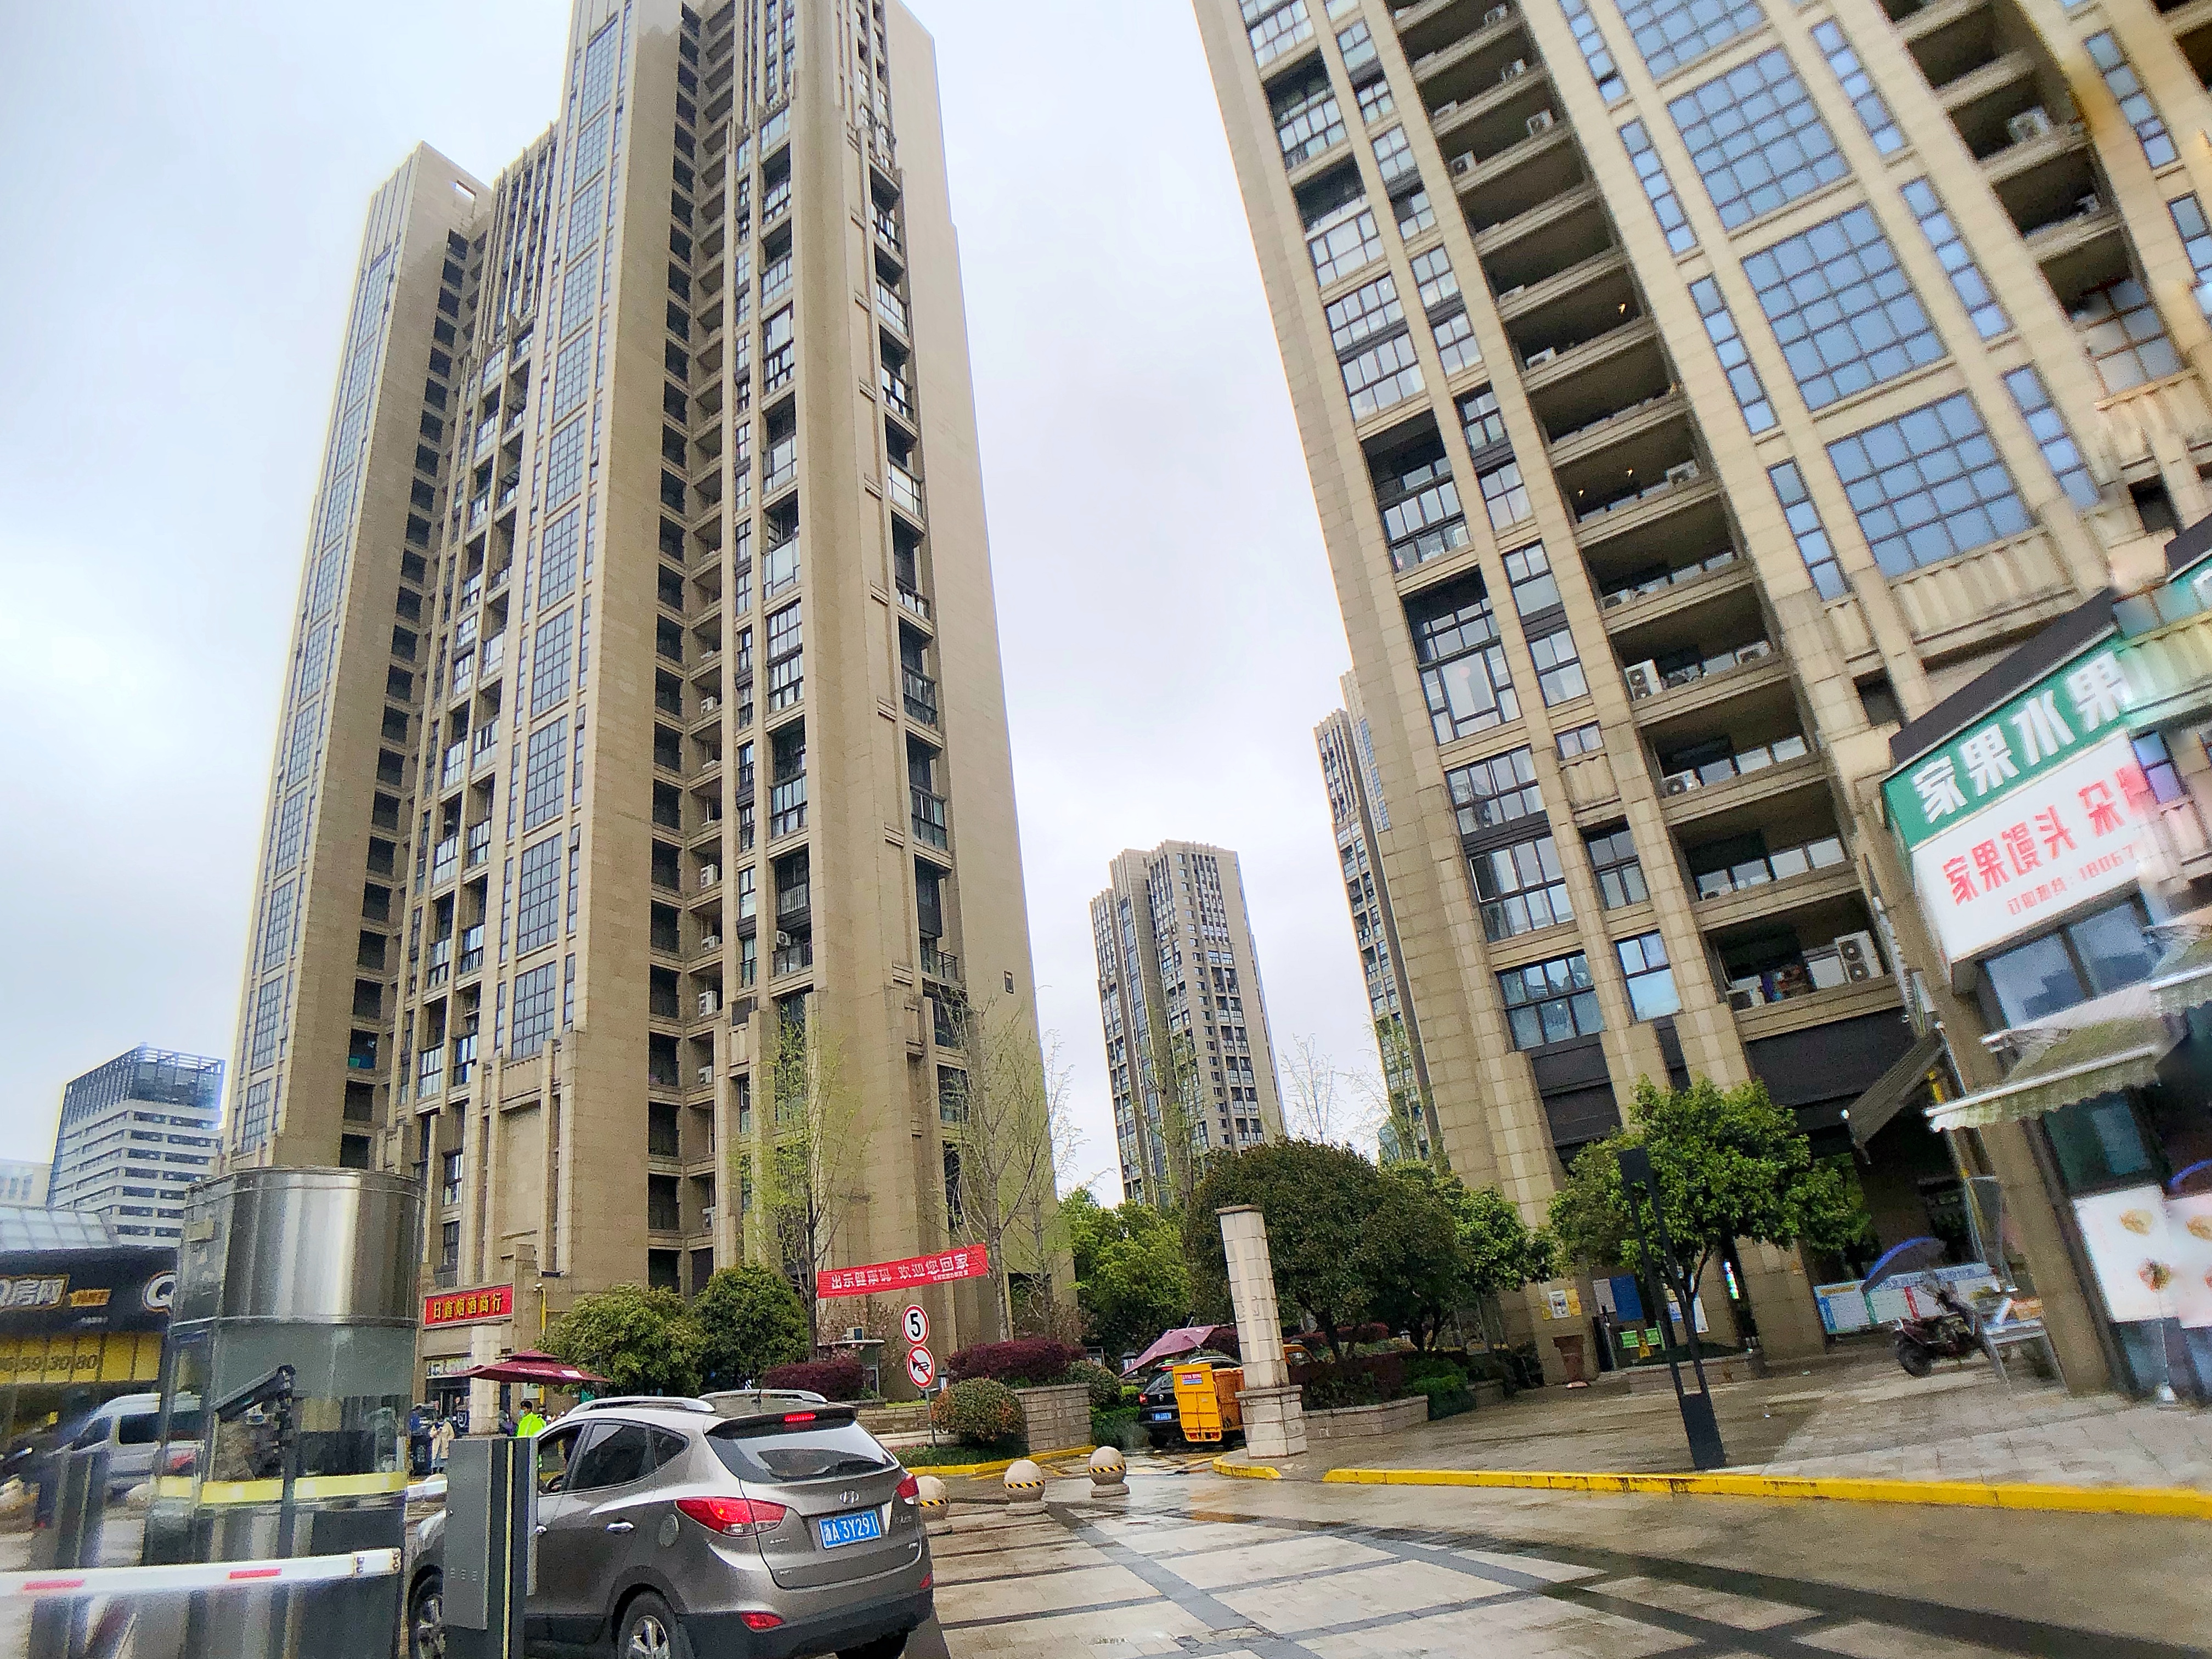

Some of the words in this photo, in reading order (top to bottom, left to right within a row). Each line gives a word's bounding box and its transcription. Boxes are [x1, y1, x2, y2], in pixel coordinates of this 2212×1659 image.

[1912, 651, 2133, 823] 家果水果
[1943, 804, 2078, 906] 家果馒头
[831, 1267, 892, 1289] 出示健康码
[898, 1253, 969, 1279] 欢迎您回家
[910, 1312, 921, 1337] 5
